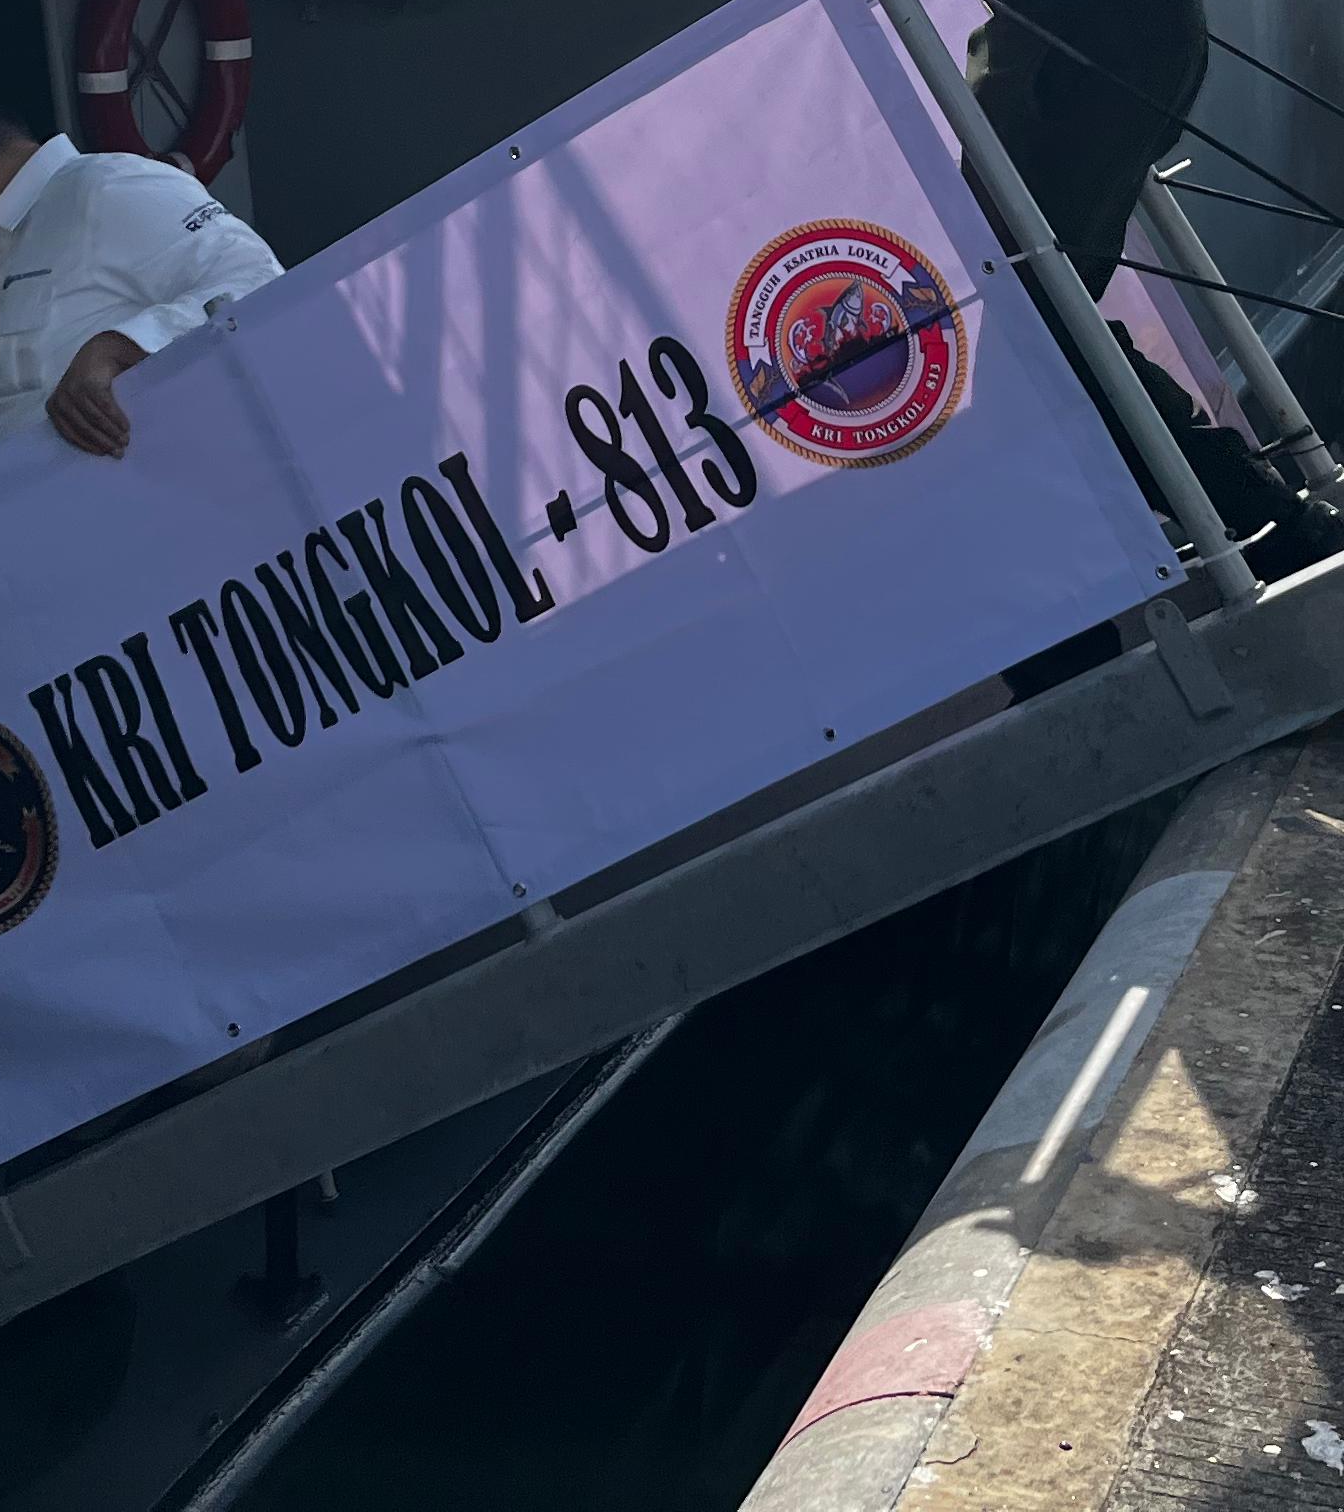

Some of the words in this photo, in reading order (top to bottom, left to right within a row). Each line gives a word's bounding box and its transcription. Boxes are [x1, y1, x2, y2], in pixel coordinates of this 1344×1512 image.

[749, 274, 781, 338] TANGGUH
[783, 244, 840, 274] KSATRIA
[848, 245, 889, 269] LOYAL
[811, 424, 843, 443] KRI
[852, 400, 926, 444] TONGKOL
[926, 362, 942, 391] 813
[29, 631, 208, 850] KRI
[168, 451, 556, 774] TONGKOL
[564, 335, 758, 554] 813
